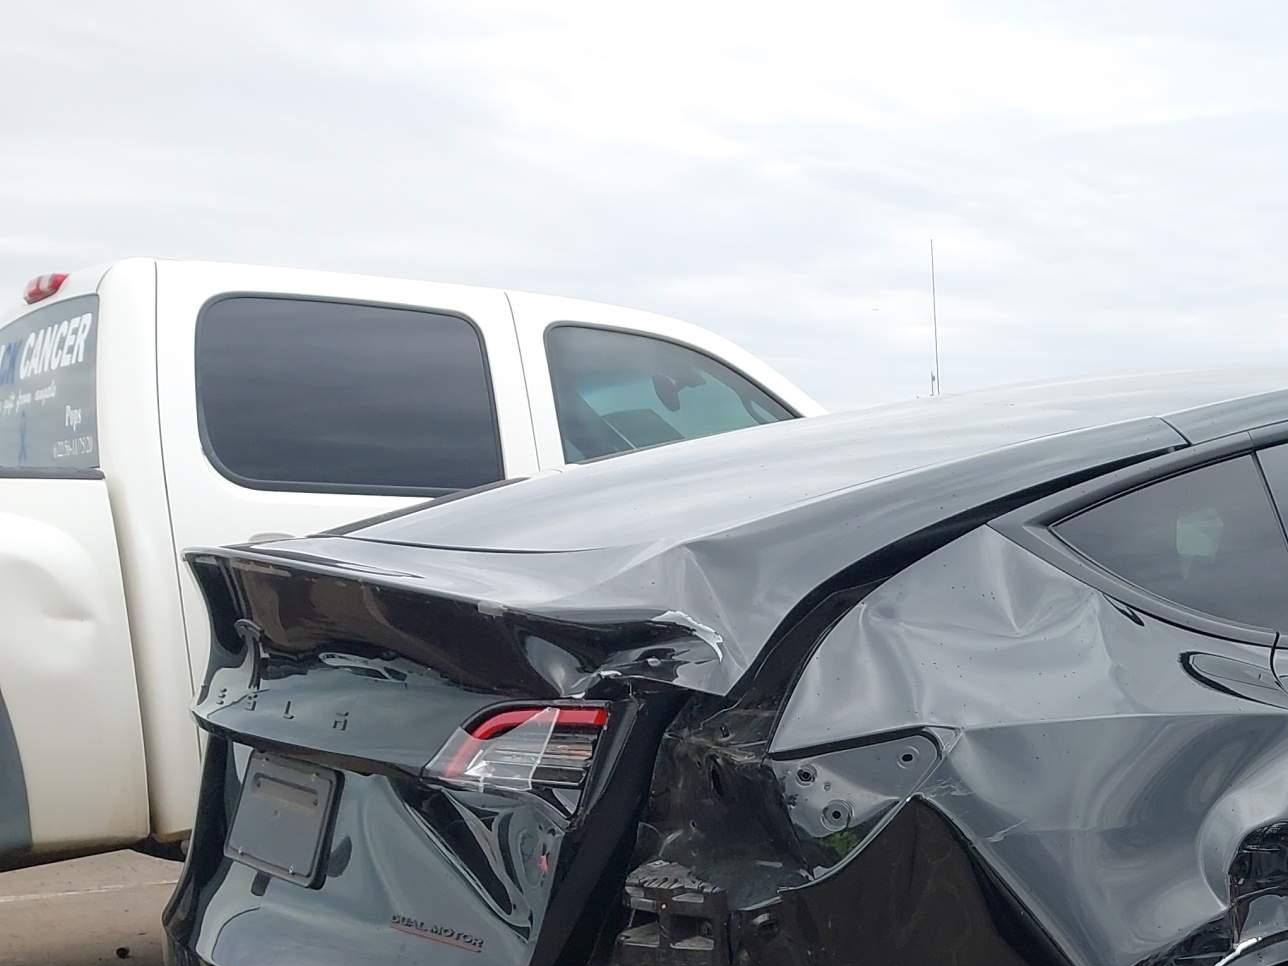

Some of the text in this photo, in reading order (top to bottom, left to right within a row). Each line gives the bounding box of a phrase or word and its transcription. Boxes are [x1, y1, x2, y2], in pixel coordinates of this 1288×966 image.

[20, 312, 92, 380] CANCER
[391, 914, 484, 948] DUAL MOTOR
